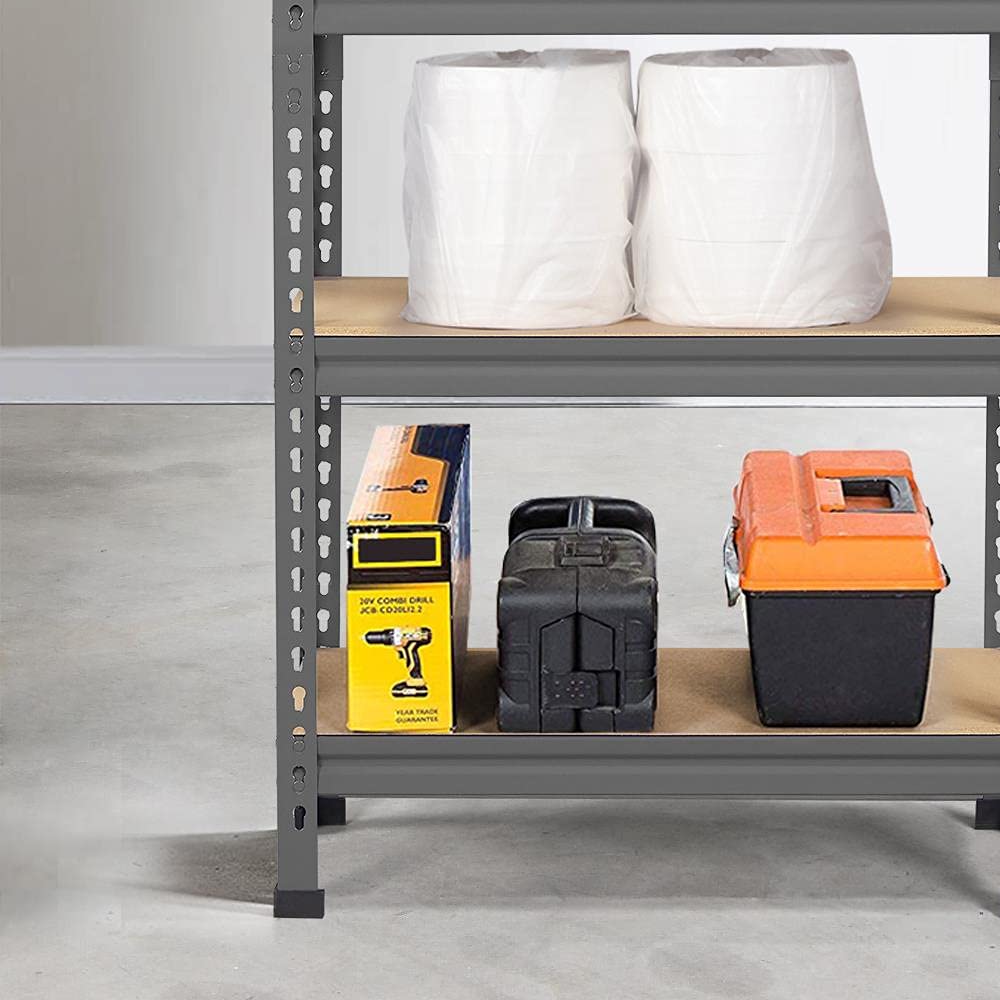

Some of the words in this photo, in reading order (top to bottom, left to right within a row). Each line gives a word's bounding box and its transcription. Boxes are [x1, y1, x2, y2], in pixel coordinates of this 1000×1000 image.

[377, 596, 407, 605] COMBI
[409, 596, 434, 604] DRILL
[395, 716, 438, 724] GUARANTEE
